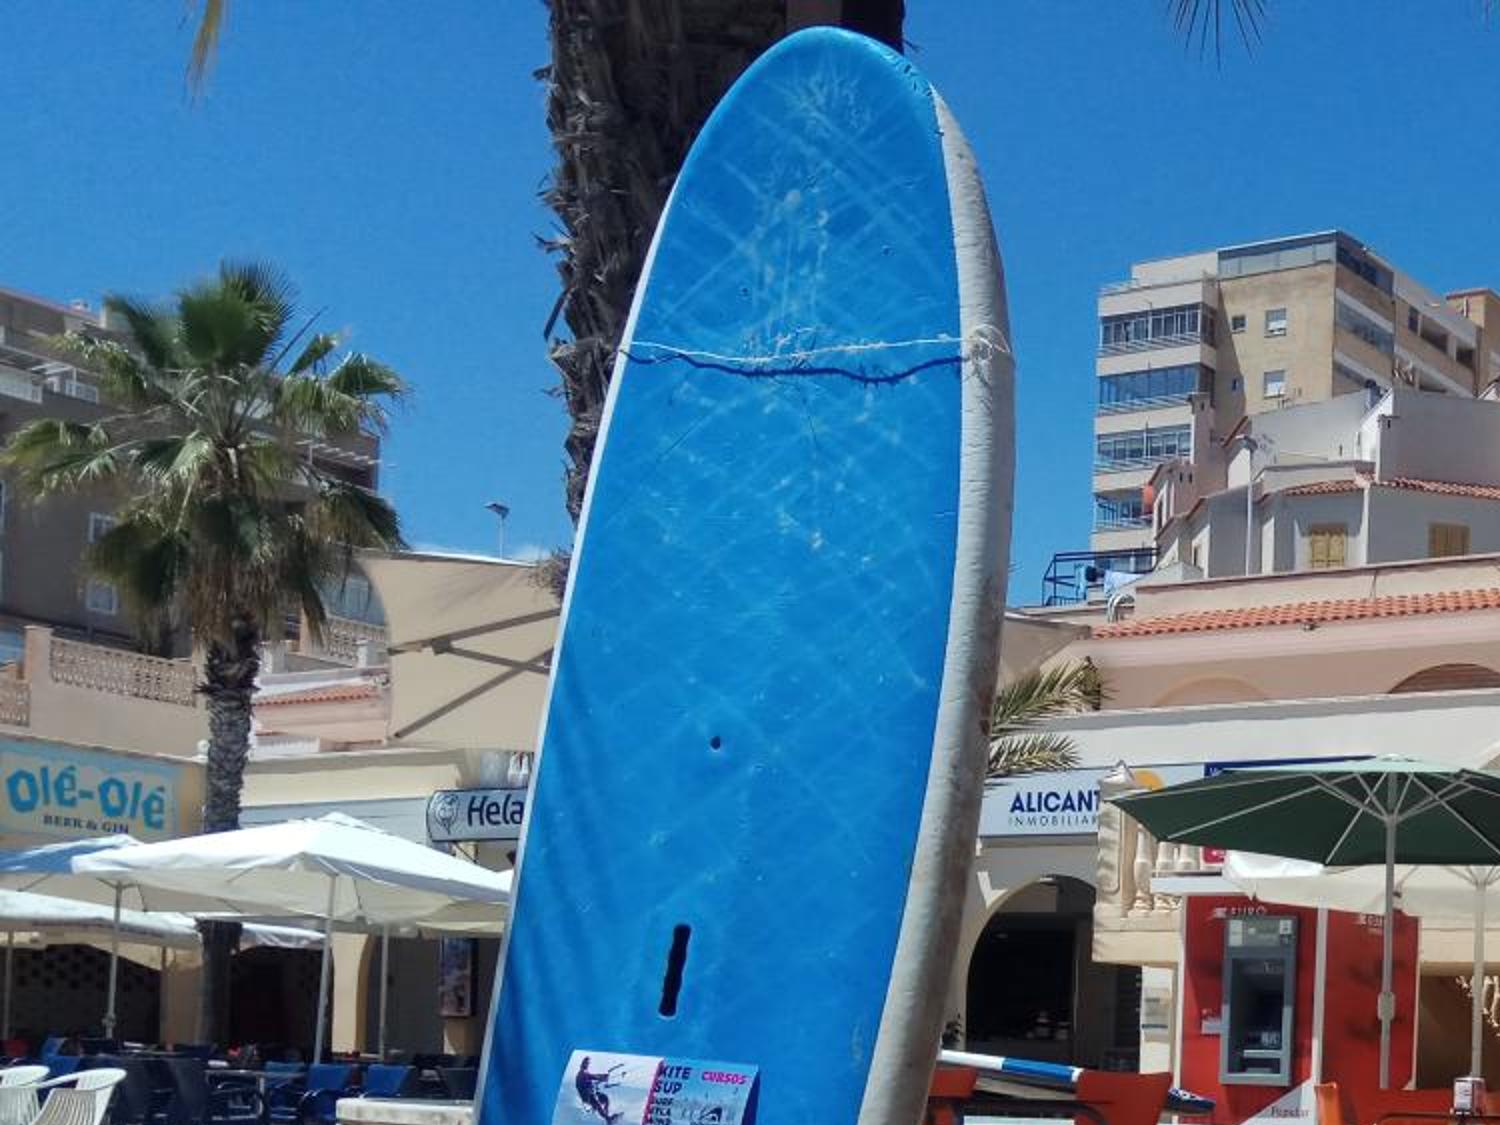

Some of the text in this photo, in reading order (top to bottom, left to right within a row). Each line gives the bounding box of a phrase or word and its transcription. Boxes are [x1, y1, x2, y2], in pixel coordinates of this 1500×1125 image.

[1010, 790, 1100, 812] ALICANT
[467, 794, 524, 827] Hela
[43, 815, 83, 828] BEER
[102, 819, 129, 833] GIN
[658, 1065, 692, 1081] KITE
[654, 1081, 683, 1095] SUP
